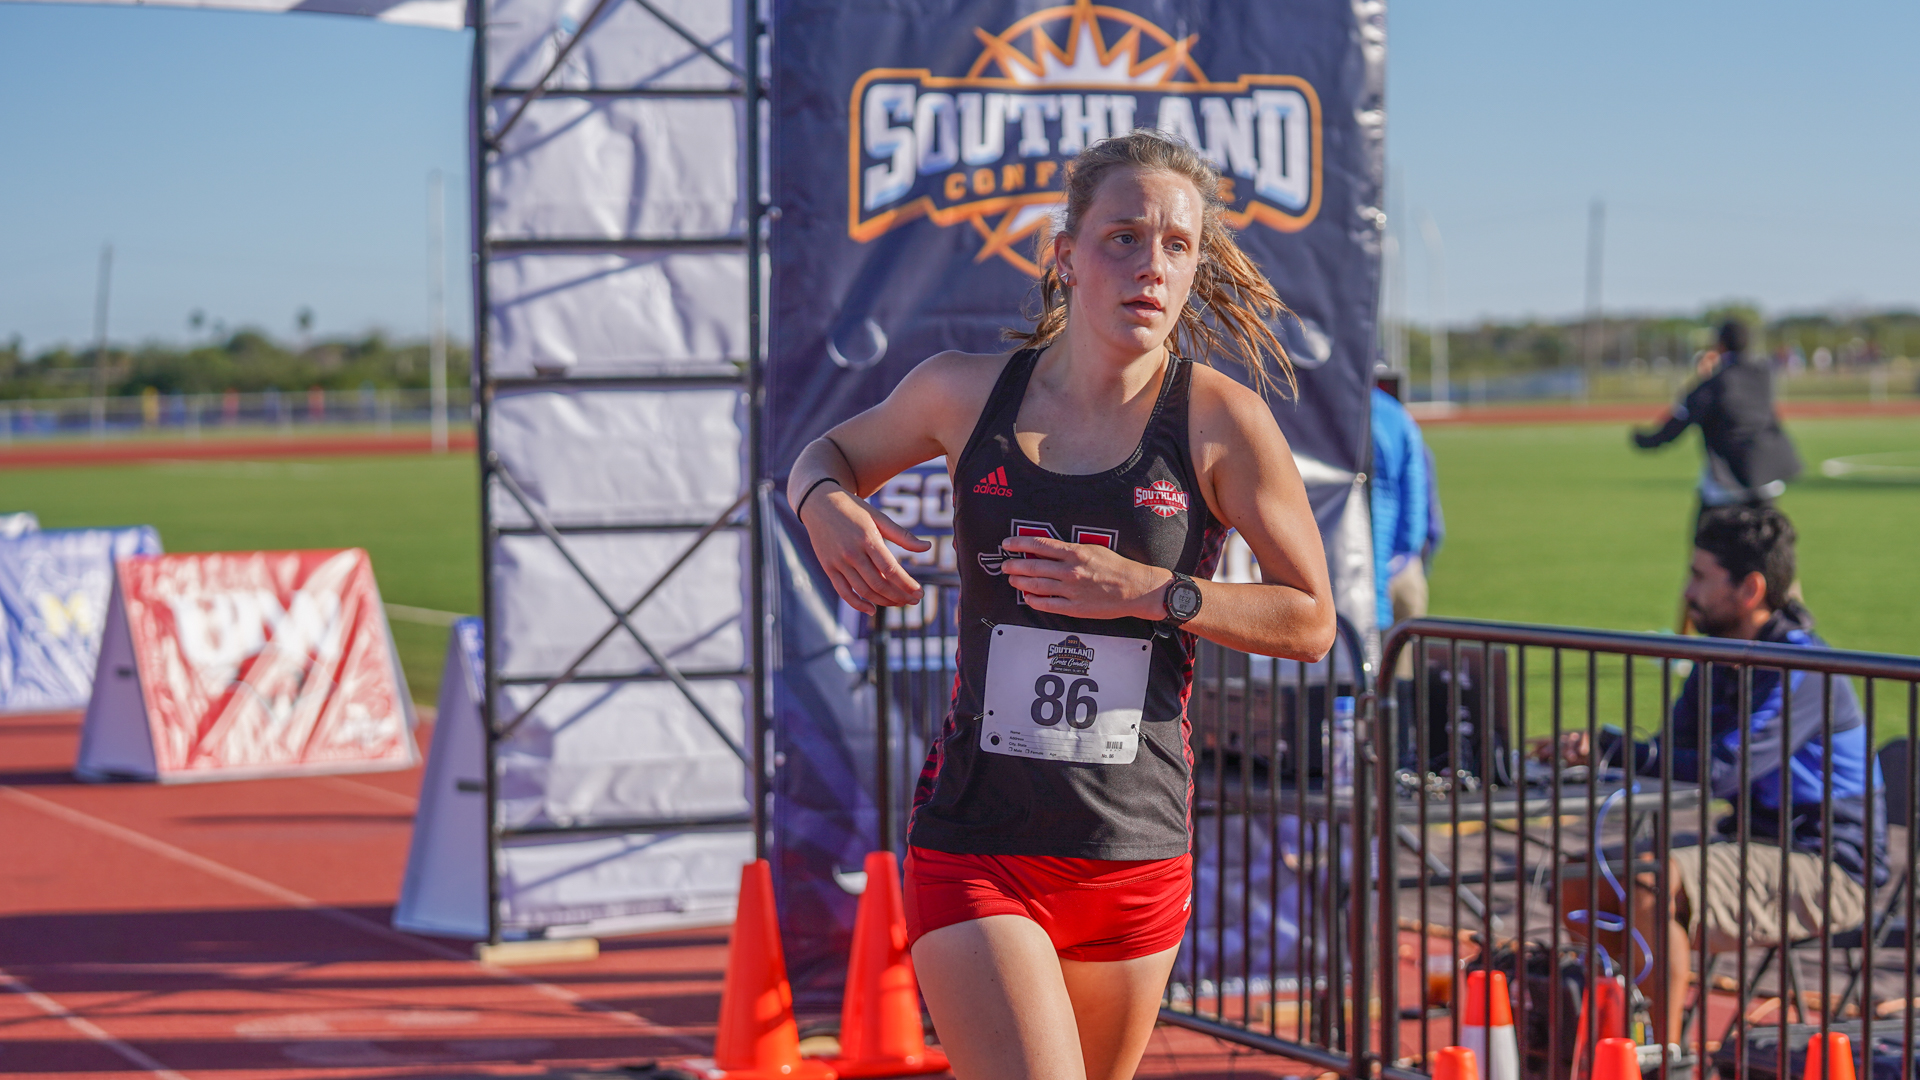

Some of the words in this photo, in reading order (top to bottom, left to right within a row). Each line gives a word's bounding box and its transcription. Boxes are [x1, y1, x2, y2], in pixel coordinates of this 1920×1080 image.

[973, 483, 1013, 497] adidas
[1136, 488, 1188, 508] SOUTHLAND
[1048, 645, 1094, 661] SOUTHLAND
[1030, 674, 1099, 730] 86
